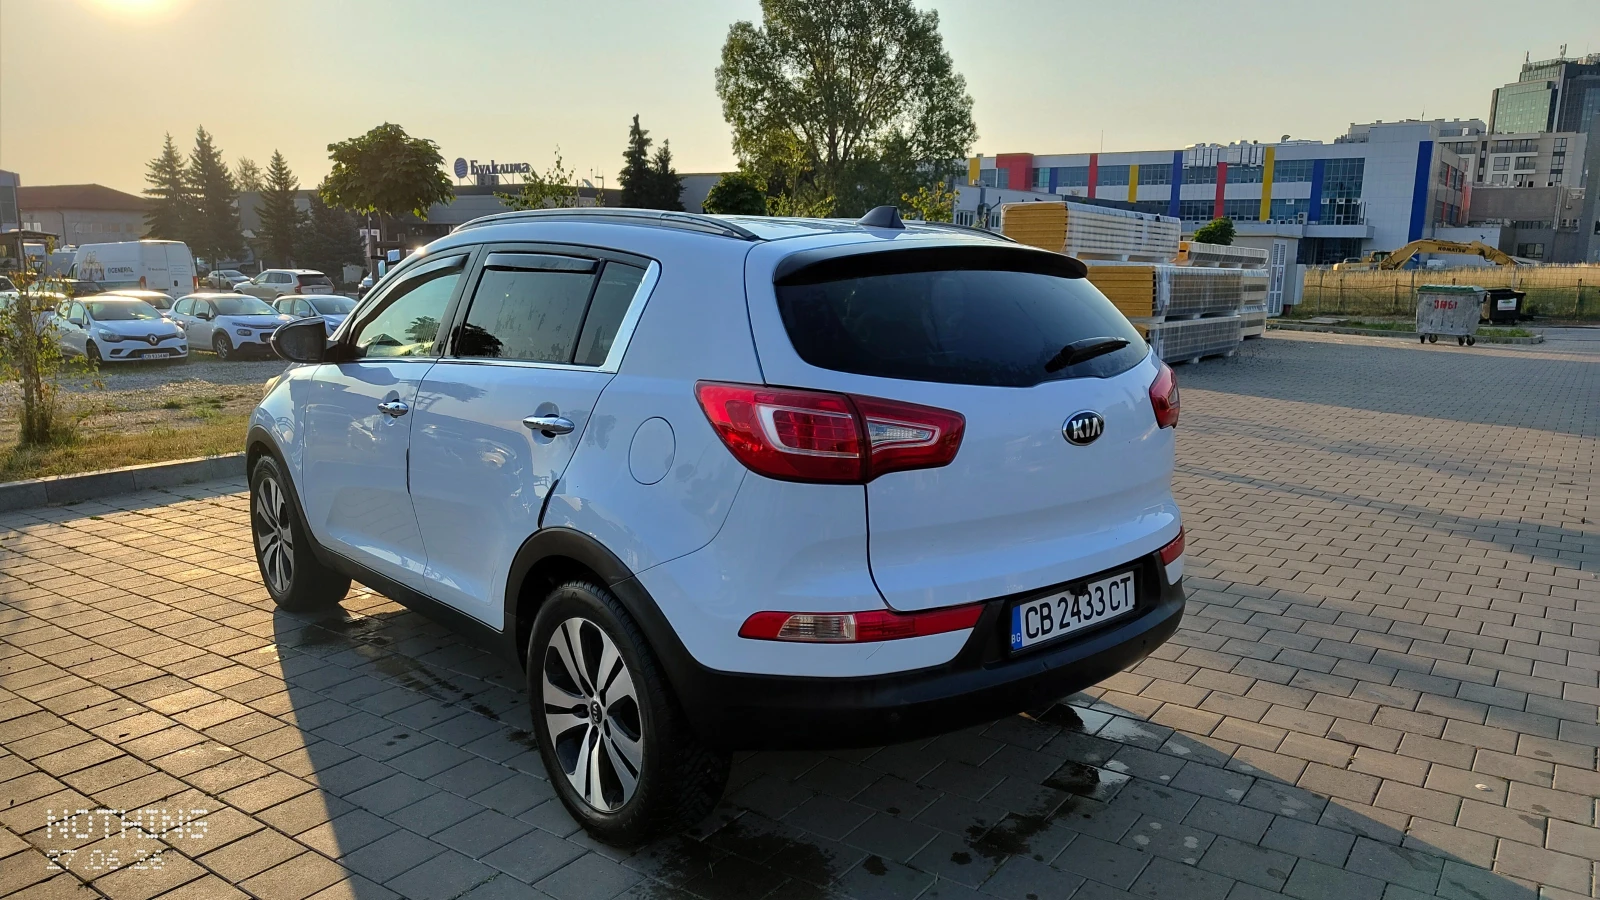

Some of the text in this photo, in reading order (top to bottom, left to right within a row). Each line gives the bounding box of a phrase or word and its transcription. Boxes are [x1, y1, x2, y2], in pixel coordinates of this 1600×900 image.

[1071, 417, 1101, 440] KIA
[1025, 576, 1131, 639] CB 2433 CT
[1011, 632, 1021, 644] BG
